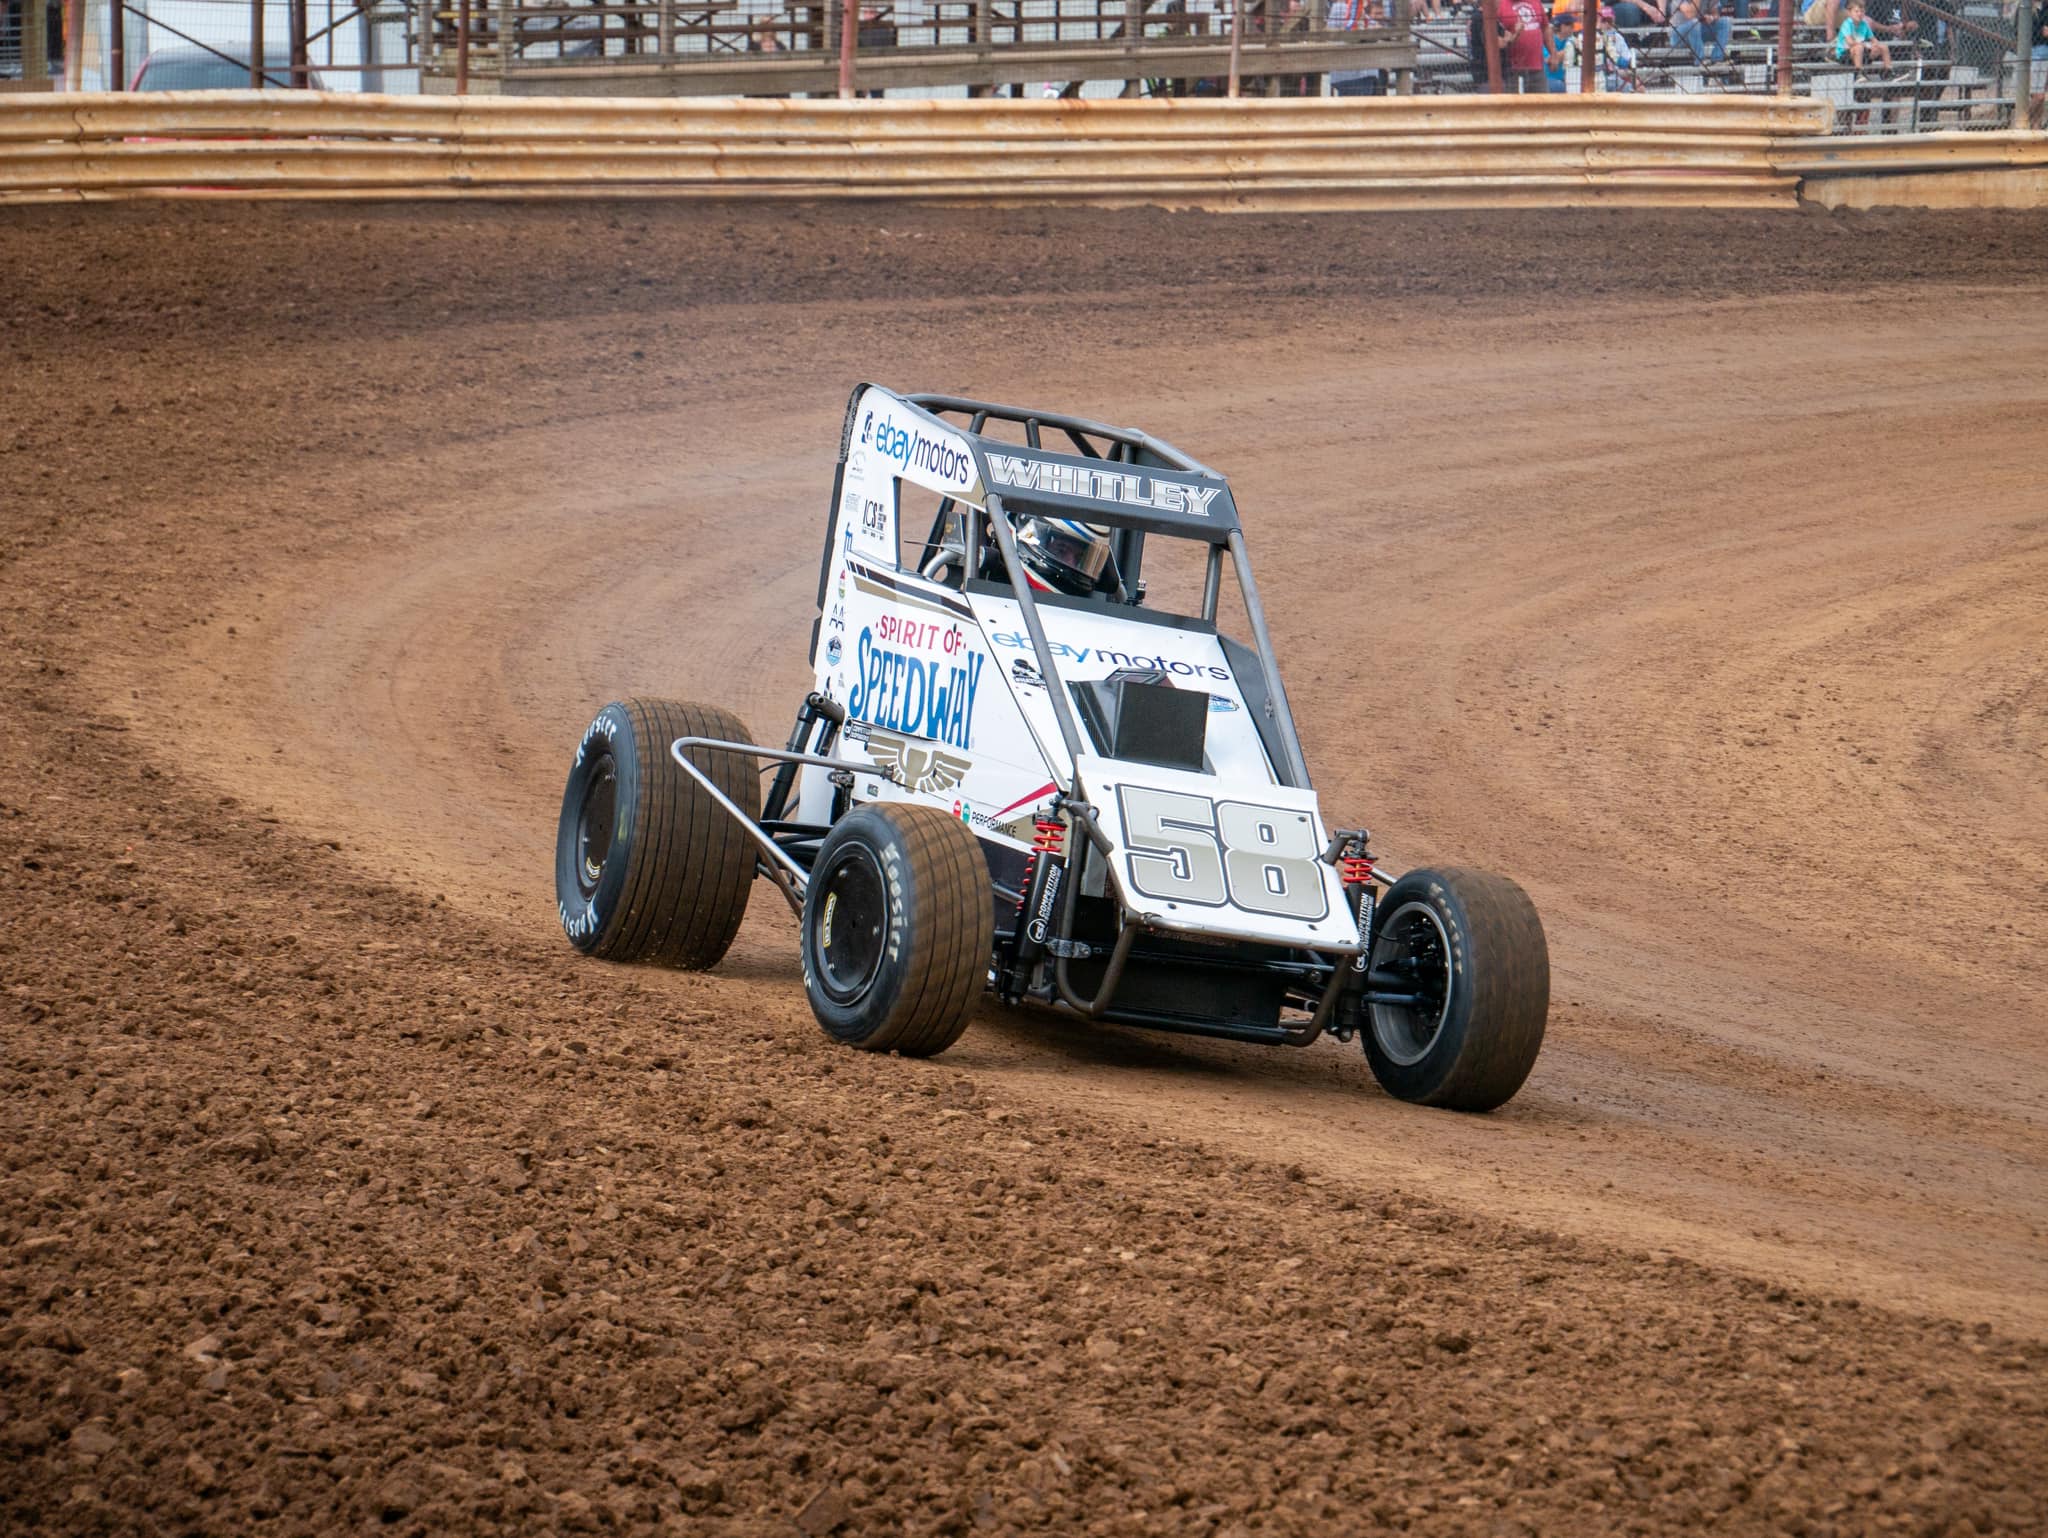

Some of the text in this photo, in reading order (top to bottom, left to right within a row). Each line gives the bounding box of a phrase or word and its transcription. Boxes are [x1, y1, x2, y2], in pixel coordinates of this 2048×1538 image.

[876, 414, 969, 485] ebay motors
[983, 452, 1222, 516] WHITLEY
[880, 615, 962, 656] SPIRIT OF
[992, 632, 1230, 681] ebay motors
[849, 626, 984, 750] SPEEDWAY
[971, 811, 1016, 838] PERFORMANCE
[1115, 783, 1330, 922] 58
[1039, 864, 1057, 917] COMPETITION
